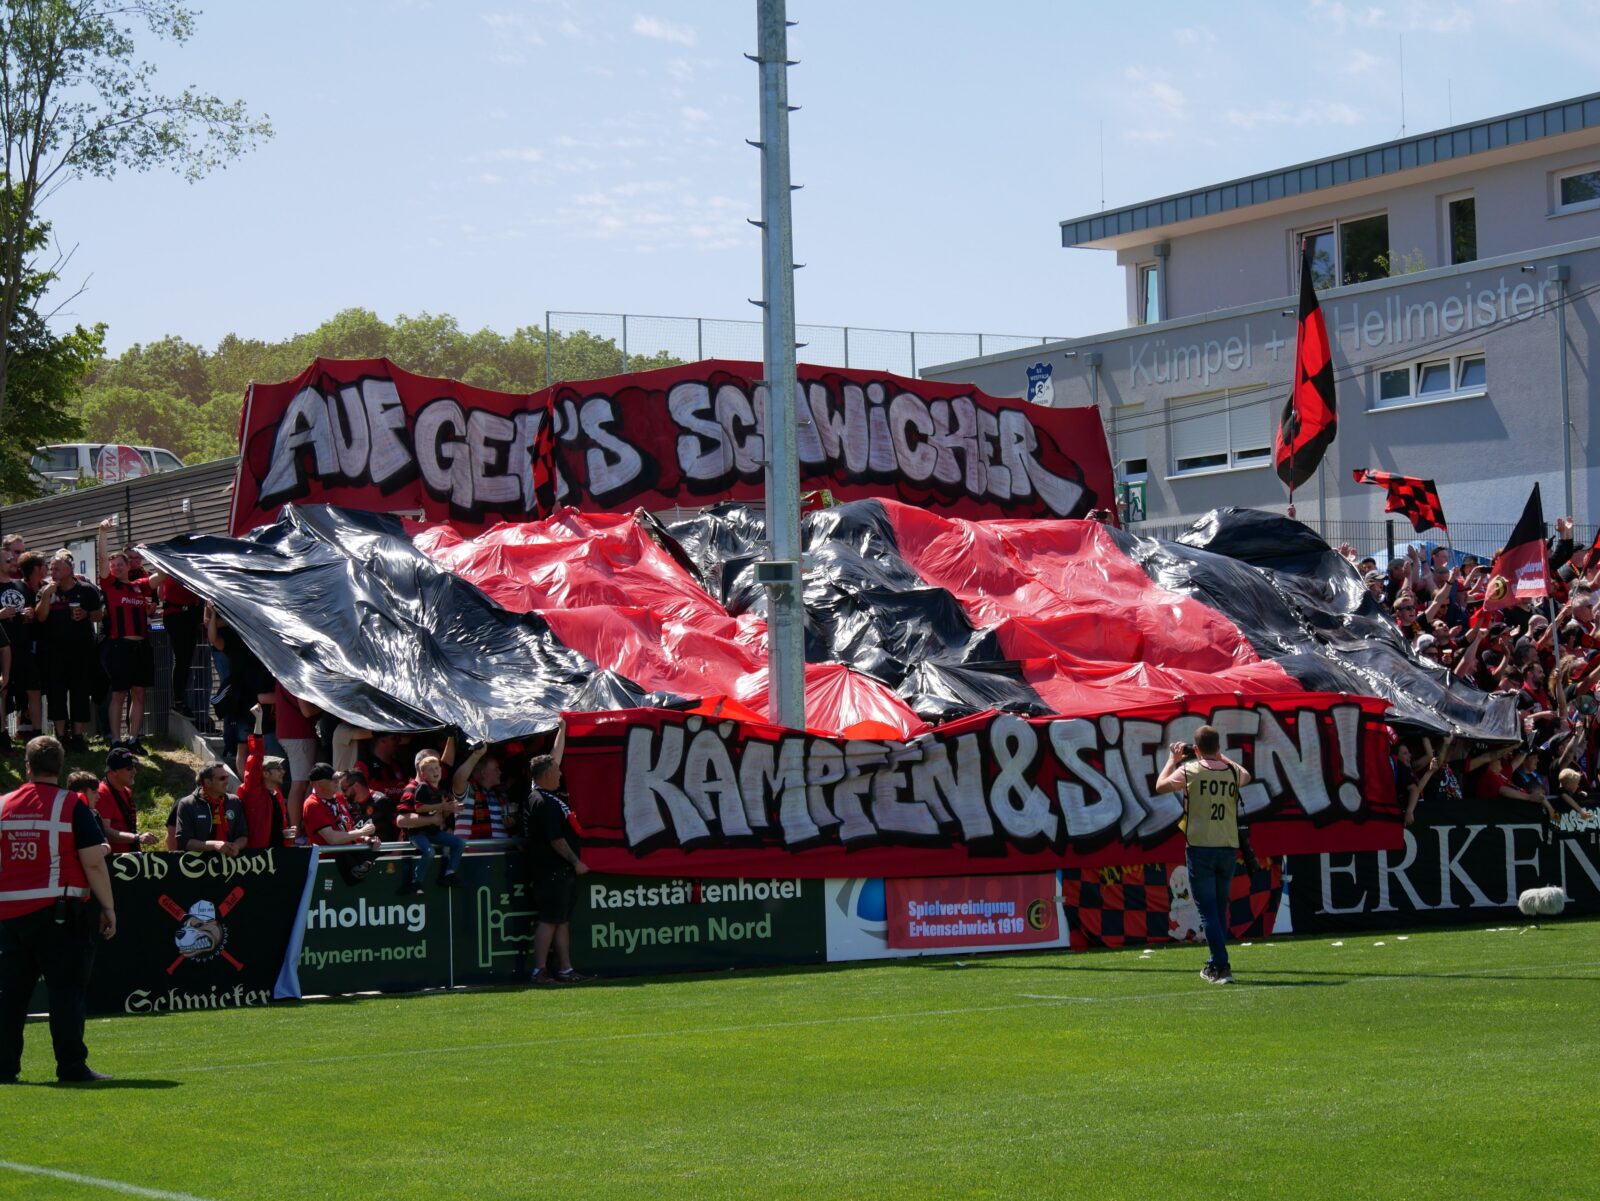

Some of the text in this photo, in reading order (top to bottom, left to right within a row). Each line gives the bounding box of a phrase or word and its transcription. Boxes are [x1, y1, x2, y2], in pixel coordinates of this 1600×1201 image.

[1129, 323, 1251, 390] Kümpel
[1333, 275, 1553, 353] Hellmeister
[623, 715, 994, 847] KÄMPFEN
[1200, 779, 1236, 797] FOTO
[1211, 803, 1225, 821] 20
[11, 841, 37, 860] 539
[112, 847, 277, 884] Old School
[908, 899, 1015, 919] Spielvereinigung
[591, 912, 771, 954] Rhynern Nord
[909, 918, 996, 937] Erkenschwick
